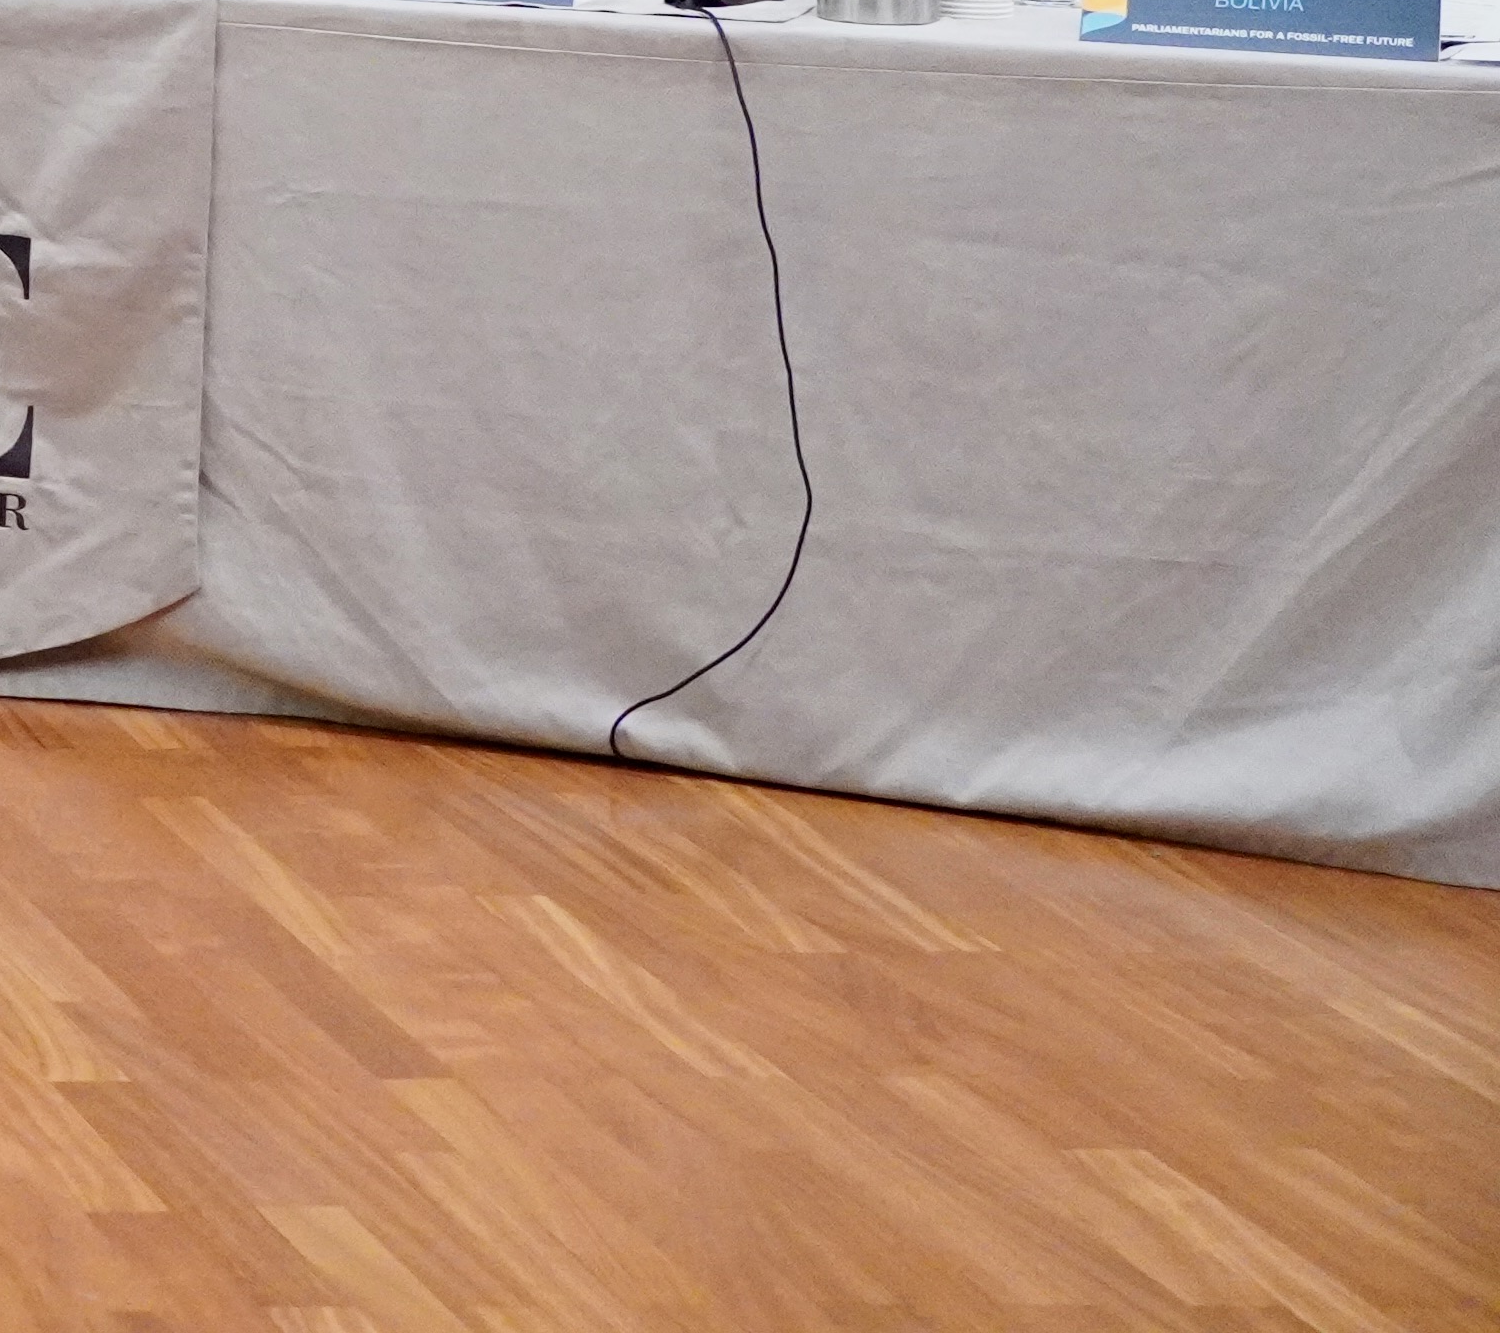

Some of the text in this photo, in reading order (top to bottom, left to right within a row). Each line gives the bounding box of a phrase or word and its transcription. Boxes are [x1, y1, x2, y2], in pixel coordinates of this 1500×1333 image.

[1131, 24, 1414, 48] PARLIAMENTARIANS FOR A FOSSIL-FREE FUTURE
